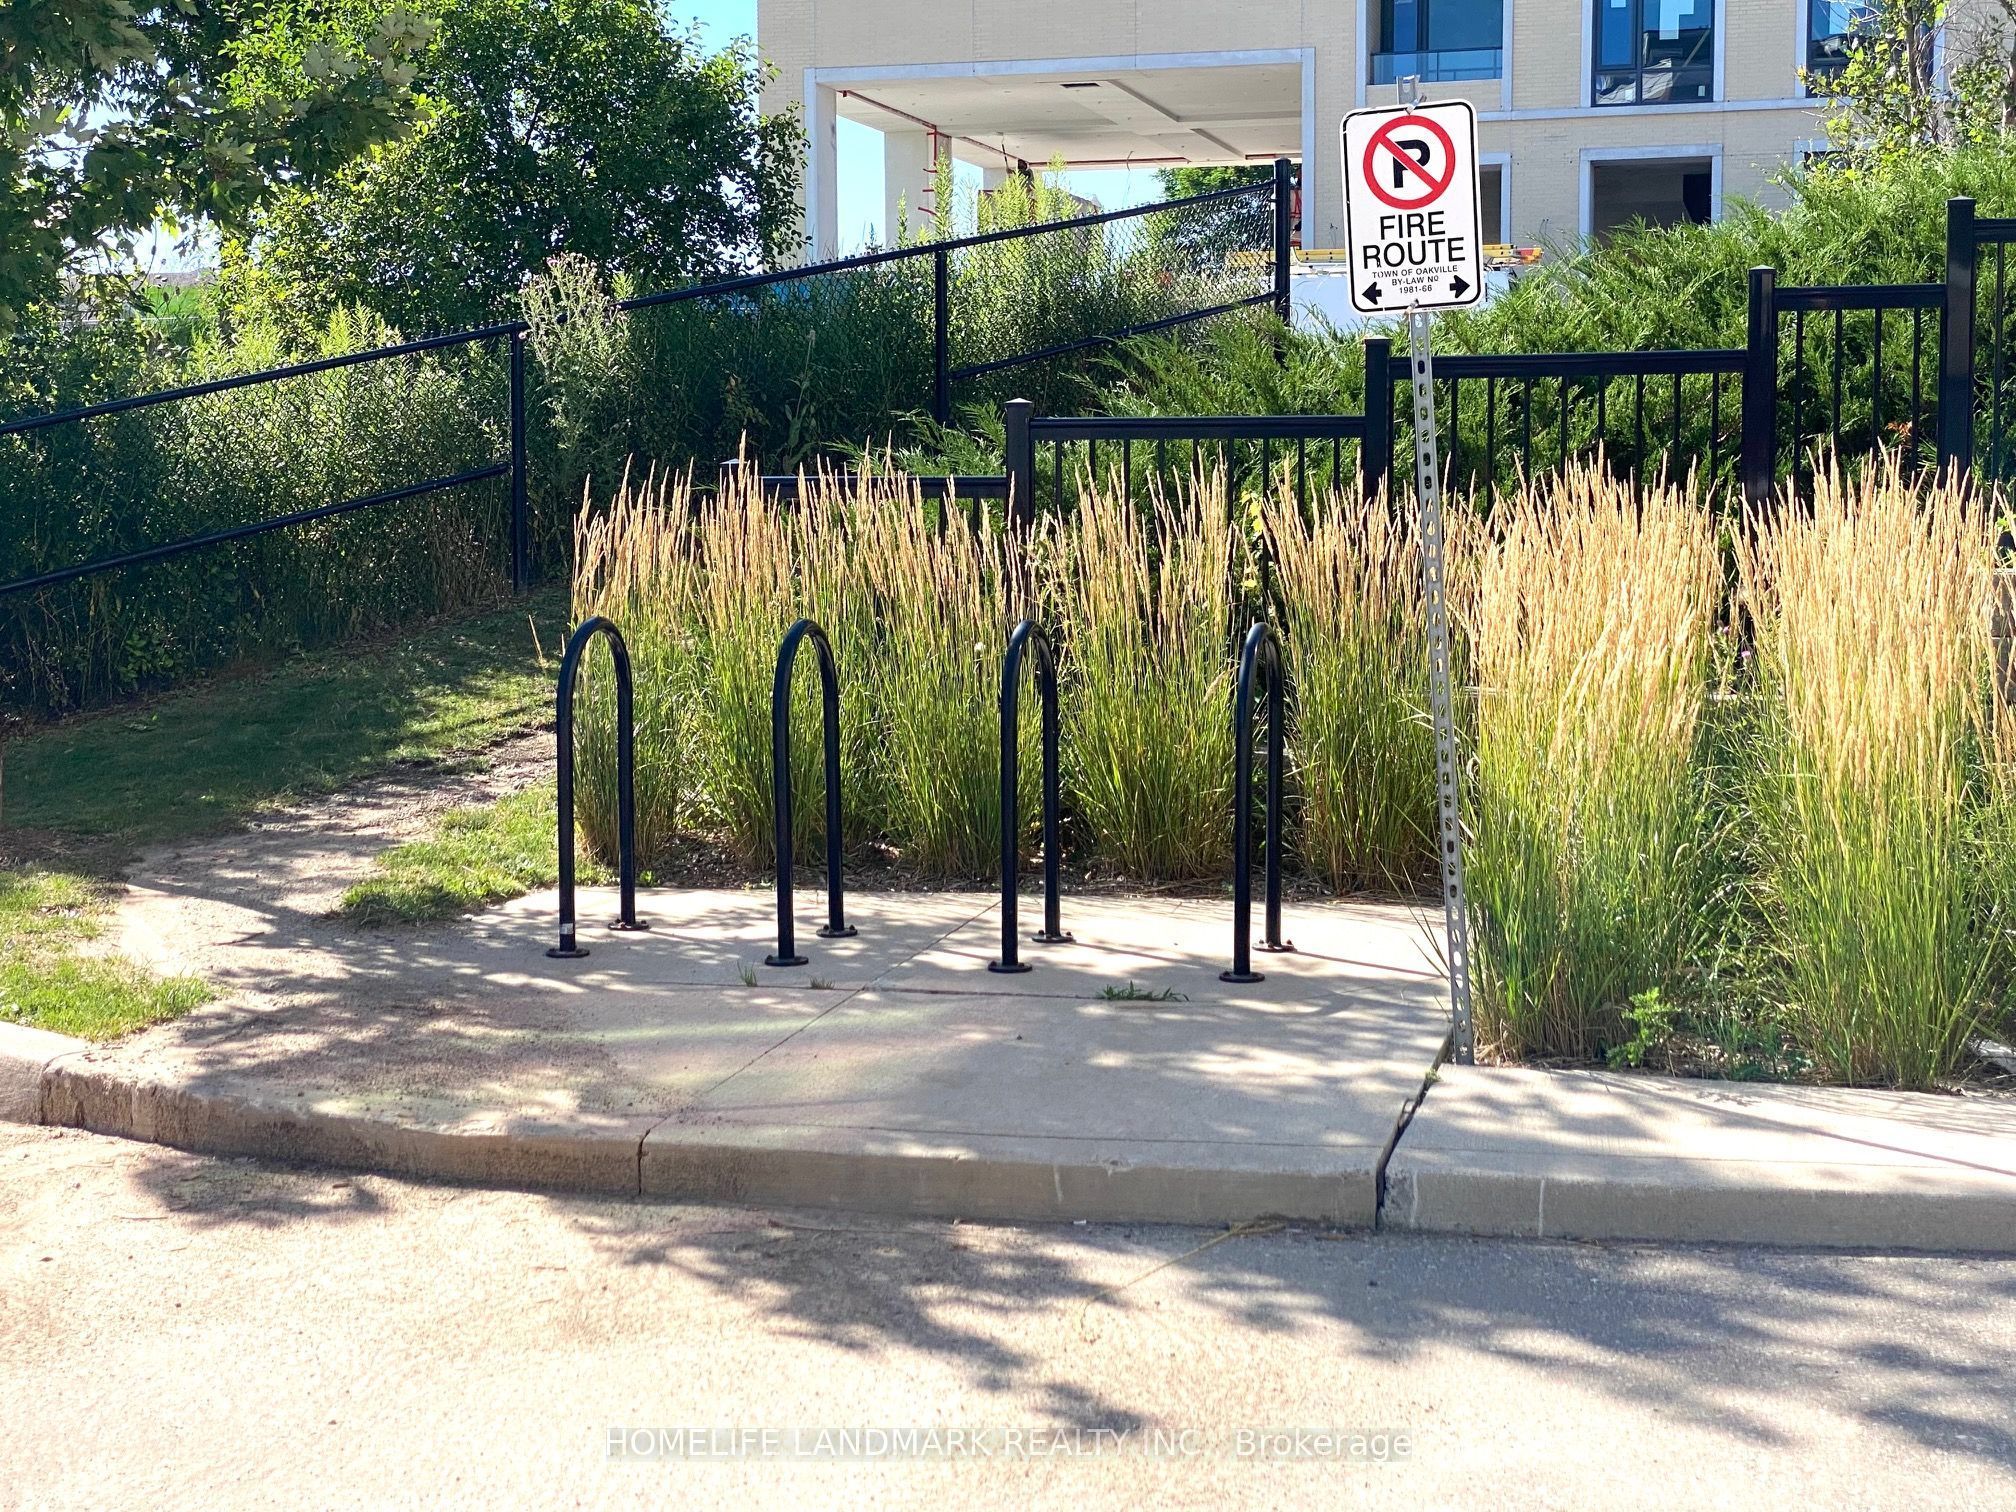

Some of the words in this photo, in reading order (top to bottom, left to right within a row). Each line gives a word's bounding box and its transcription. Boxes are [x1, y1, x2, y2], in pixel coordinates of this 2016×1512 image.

[1380, 210, 1445, 240] FIRE
[1362, 236, 1466, 269] ROUTE
[1372, 269, 1398, 279] TOWN
[1401, 268, 1413, 276] OF
[1415, 265, 1458, 275] OAKVILLE
[1392, 276, 1425, 286] BY-LAW
[1399, 284, 1433, 294] 1981-66
